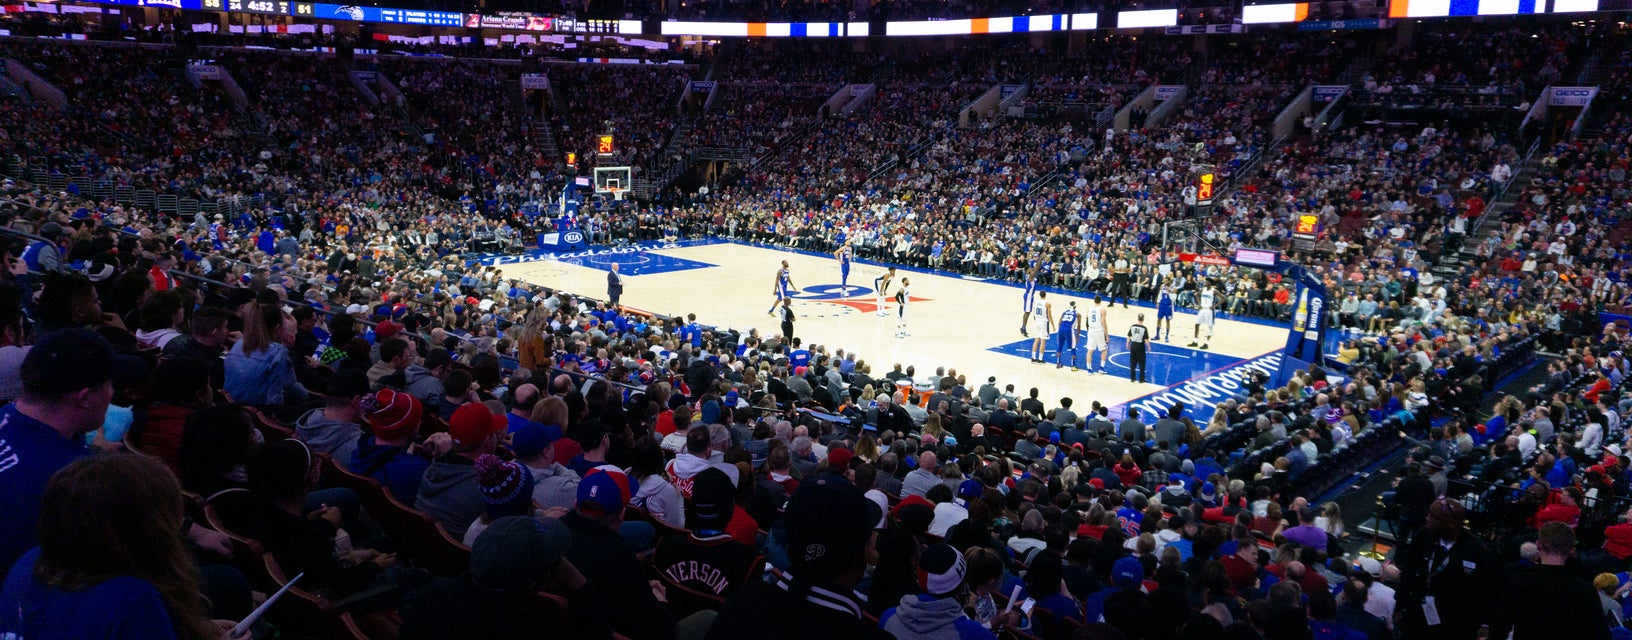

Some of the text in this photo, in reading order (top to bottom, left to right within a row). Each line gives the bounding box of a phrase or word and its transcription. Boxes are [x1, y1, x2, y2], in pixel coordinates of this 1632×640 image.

[247, 1, 274, 11] 4:52
[298, 5, 311, 14] 51
[600, 143, 611, 152] 24
[1199, 183, 1211, 199] 24
[1298, 222, 1312, 232] 24
[483, 243, 681, 266] Philadelphia
[1310, 297, 1322, 328] Corona
[1091, 313, 1097, 323] 9
